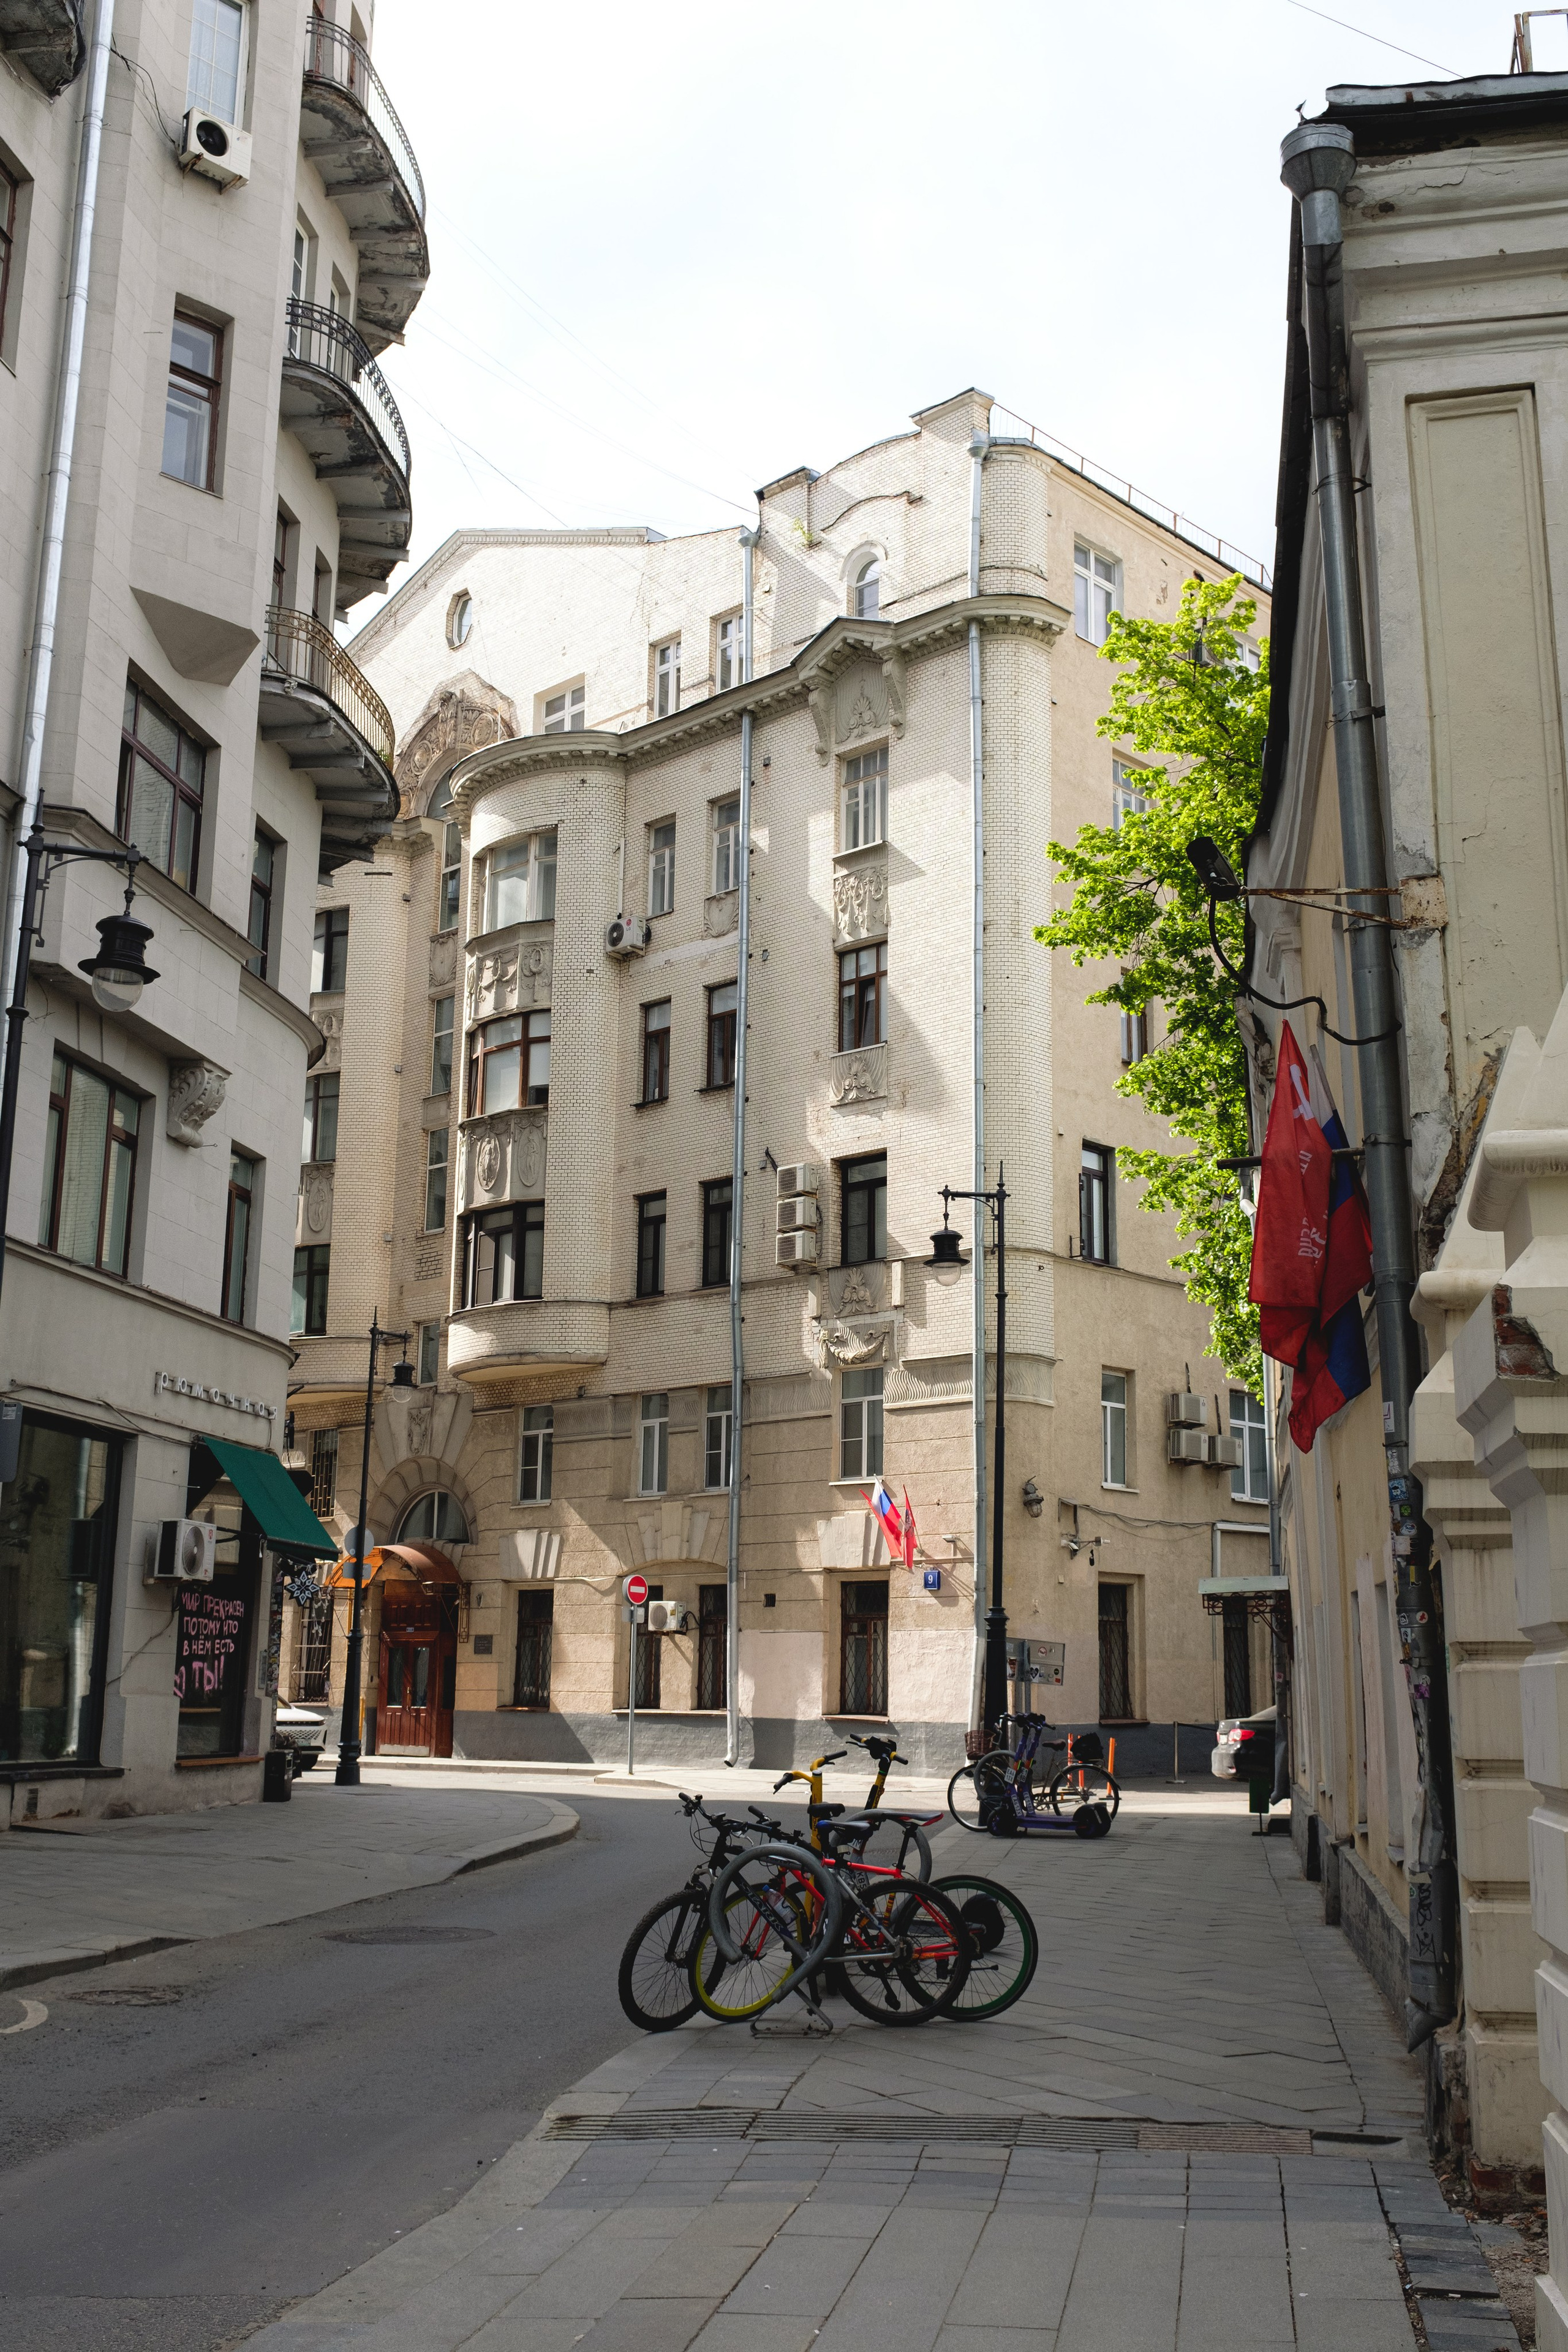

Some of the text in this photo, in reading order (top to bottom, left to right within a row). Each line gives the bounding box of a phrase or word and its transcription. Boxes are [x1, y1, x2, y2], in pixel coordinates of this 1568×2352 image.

[928, 1574, 933, 1584] 9
[182, 1592, 244, 1619] МИР ПРЕКРАСЕН
[184, 1617, 221, 1636] ПОТОМУ
[183, 1635, 235, 1656] В НЁМ ЕСТЬ
[192, 1655, 224, 1692] ТЫ!
